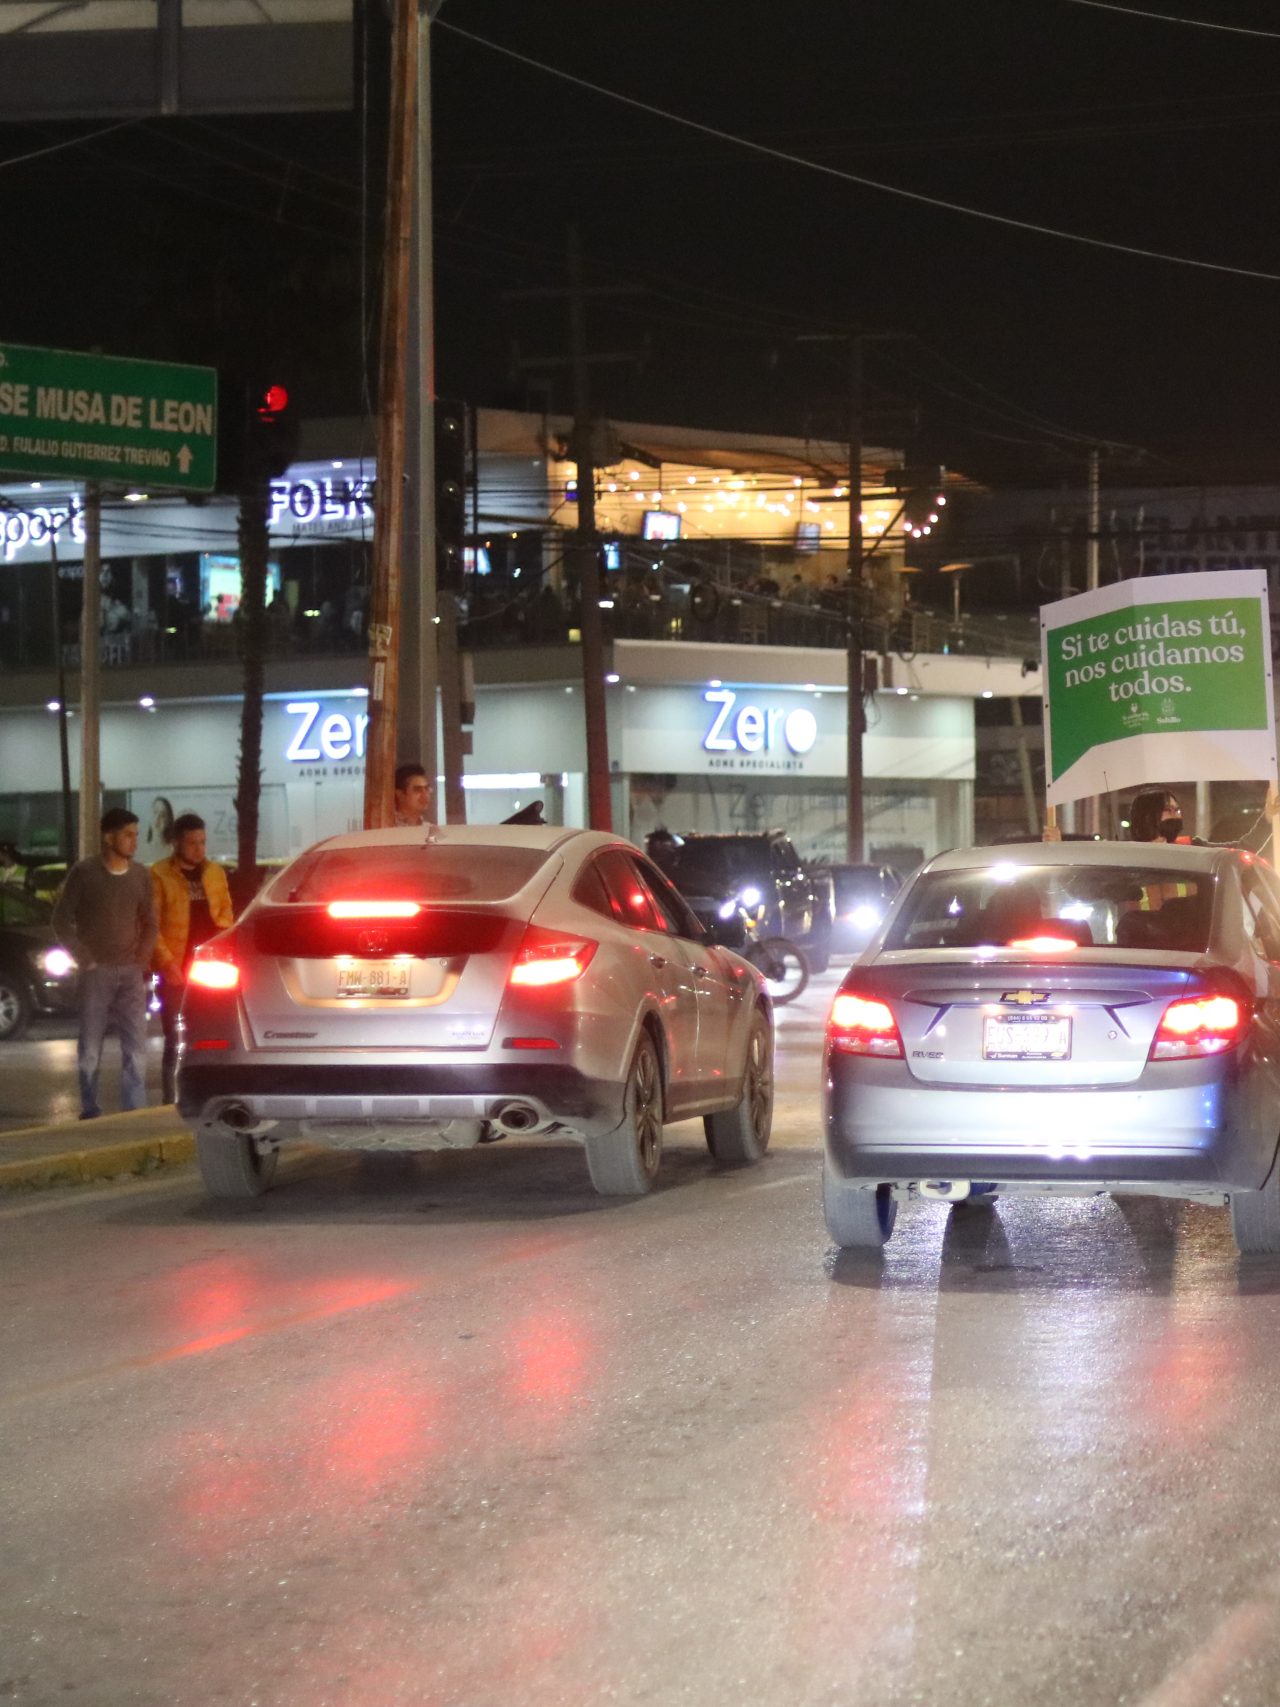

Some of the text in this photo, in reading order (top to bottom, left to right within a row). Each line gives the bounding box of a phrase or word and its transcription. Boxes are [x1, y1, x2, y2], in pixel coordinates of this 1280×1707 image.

[36, 387, 105, 424] MUSA
[110, 394, 144, 428] DE
[150, 398, 213, 435] LEON
[13, 436, 59, 456] EULALIO
[61, 441, 122, 463] GUTIERREZ
[1061, 636, 1083, 661] Si
[1088, 632, 1110, 653] te
[1114, 613, 1202, 646] cuidas
[1208, 611, 1246, 639] tú,
[1064, 662, 1106, 688] nos
[1111, 641, 1245, 674] cuidamos
[1109, 670, 1192, 702] todos.
[286, 701, 368, 761] Zer
[705, 690, 817, 753] Zero
